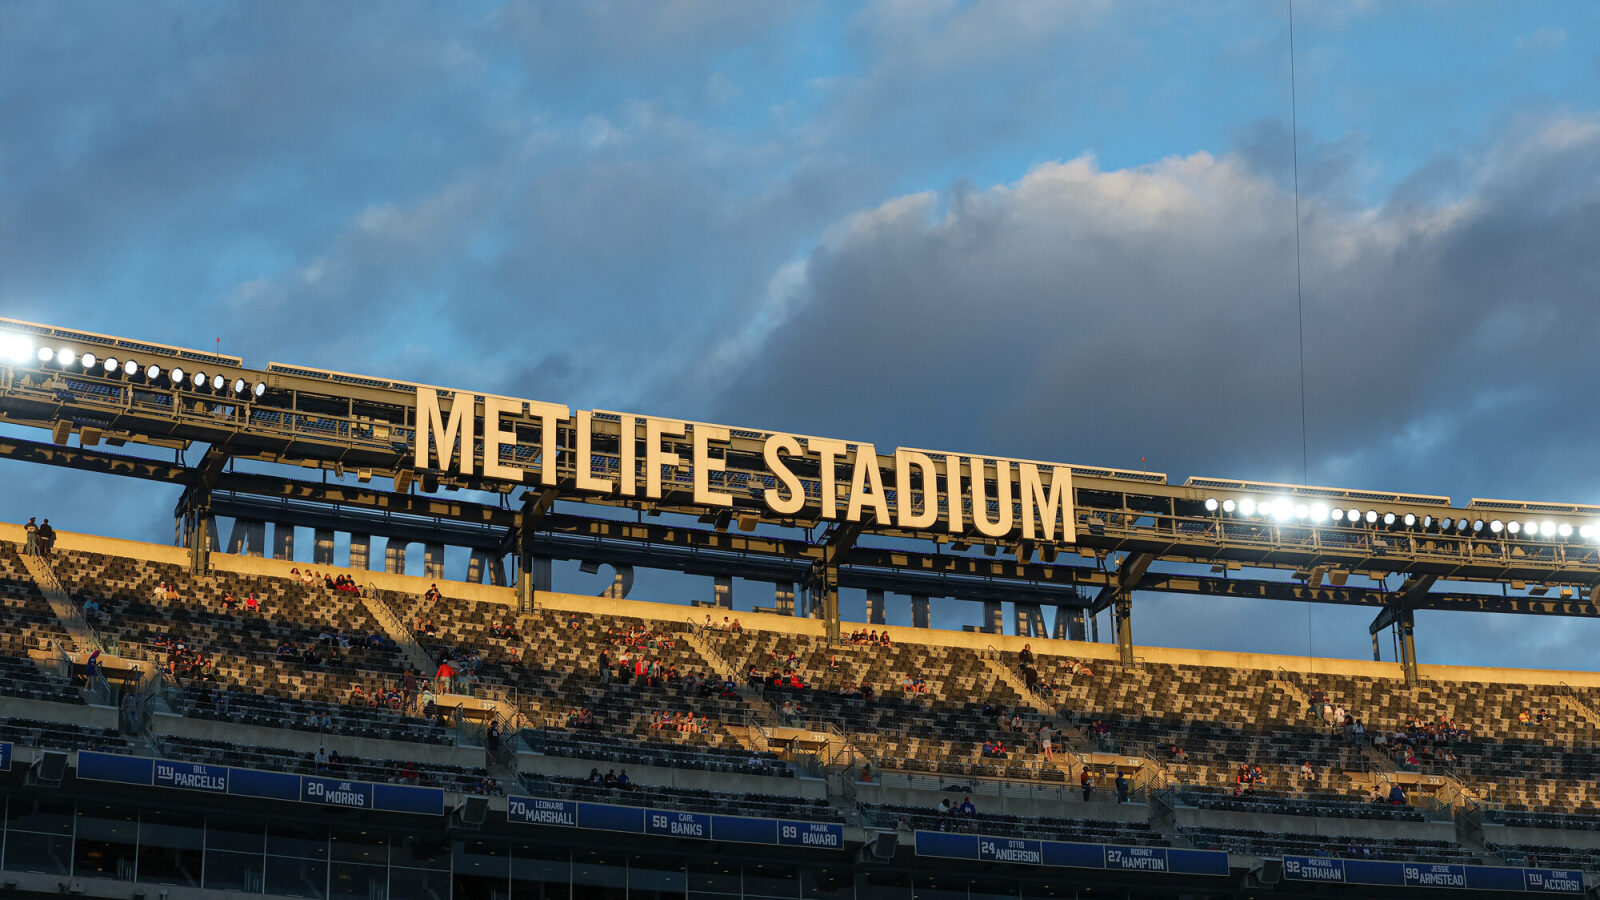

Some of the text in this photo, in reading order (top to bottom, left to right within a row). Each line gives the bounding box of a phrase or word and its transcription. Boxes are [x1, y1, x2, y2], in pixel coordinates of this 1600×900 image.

[414, 386, 1077, 543] METLIFE STADIUM
[193, 765, 207, 775] BILL
[174, 773, 225, 790] PARCELLS
[338, 782, 352, 791] JOE
[307, 782, 324, 796] 20
[325, 790, 365, 806] MORRIS
[510, 801, 526, 815] 70
[535, 800, 564, 811] LEONARD
[525, 809, 574, 825] MARSHALL
[652, 815, 668, 828] 58
[678, 813, 694, 823] CARL
[671, 822, 703, 836] BANKS
[782, 826, 797, 839] 89
[810, 824, 828, 833] MARK
[802, 832, 837, 846] BAVARO
[1008, 840, 1025, 849] OTTIS
[981, 841, 996, 855] 24
[1130, 848, 1153, 857] RODNEY
[995, 848, 1040, 863] ANDERSON
[1107, 850, 1122, 863] 27
[1121, 857, 1164, 870] HAMPTON
[1286, 861, 1300, 873] 92
[1308, 858, 1332, 868] MICHAEL
[1430, 865, 1450, 873] JESSIE
[1301, 866, 1342, 880] STRAHAN
[1405, 867, 1419, 880] 98
[1419, 872, 1464, 886] ARMSTEAD
[1544, 879, 1580, 891] ACCORSI
